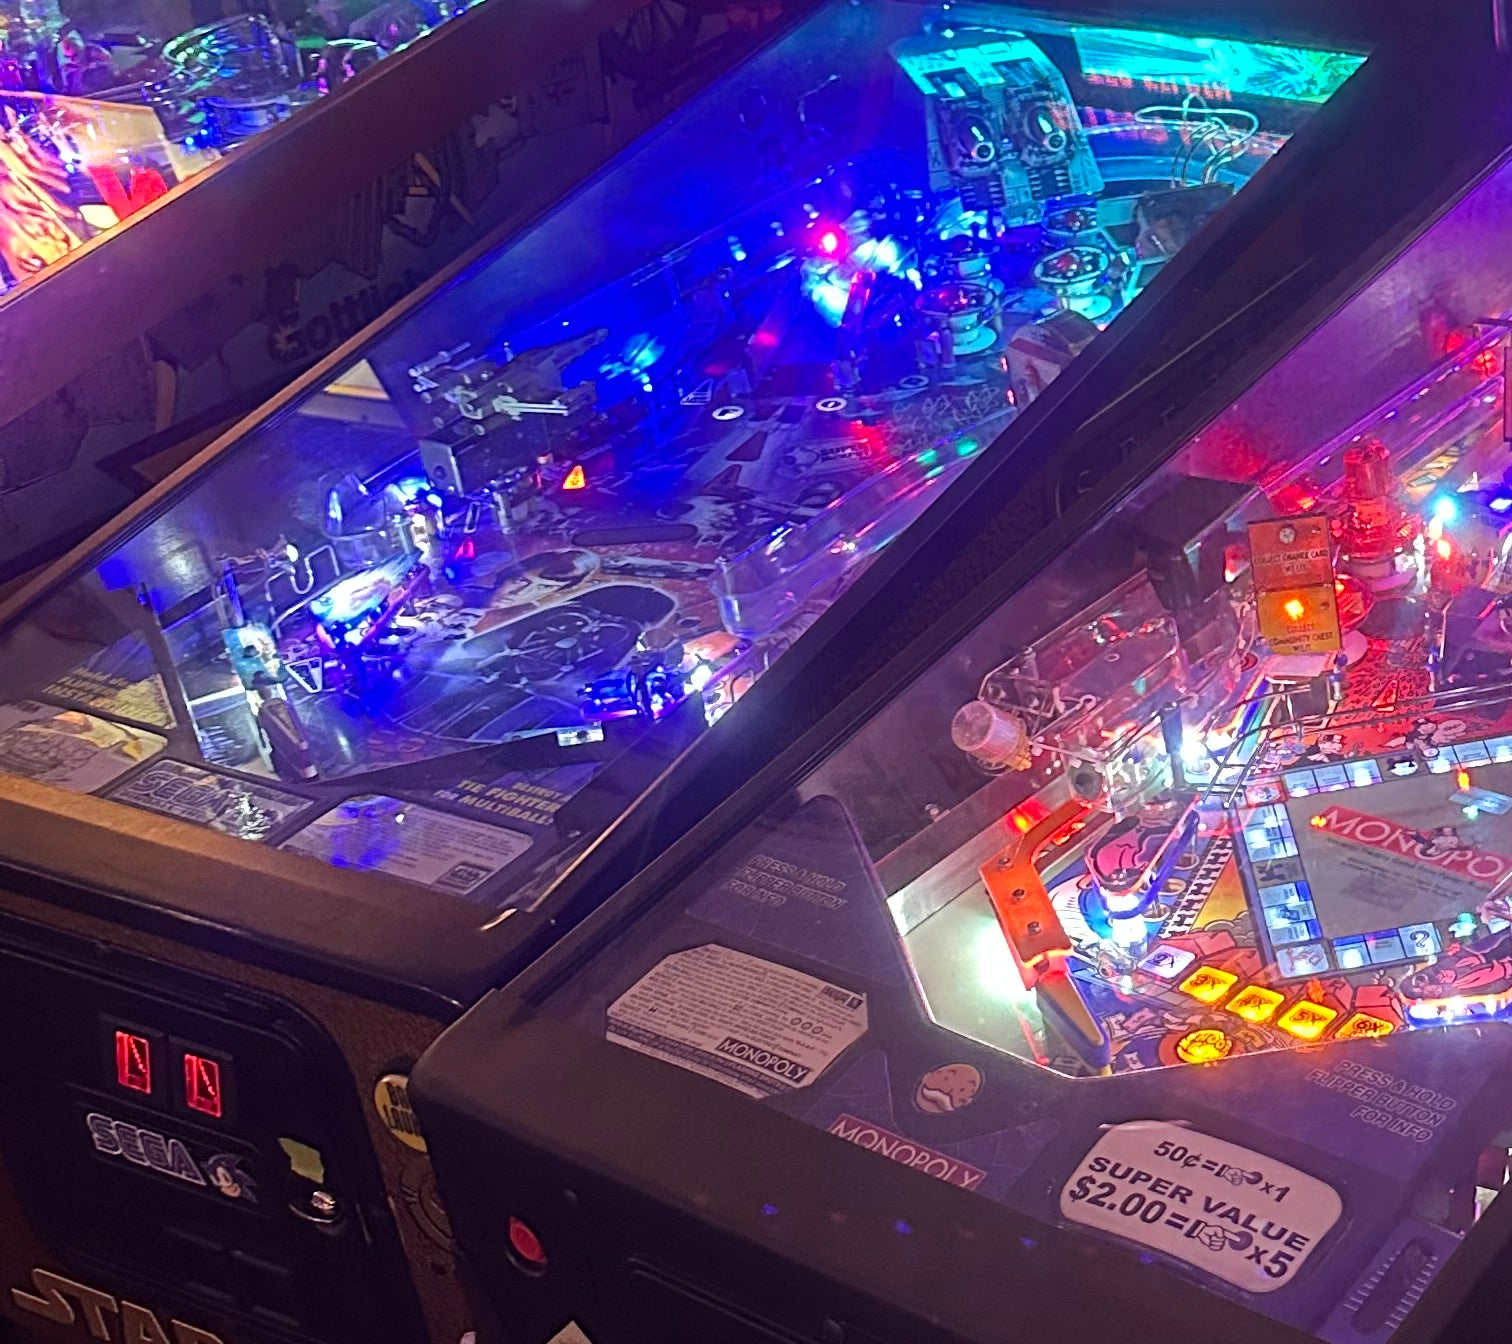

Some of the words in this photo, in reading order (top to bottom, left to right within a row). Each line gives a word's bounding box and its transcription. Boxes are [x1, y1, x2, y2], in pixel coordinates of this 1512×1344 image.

[1311, 631, 1334, 642] CHEST
[433, 789, 457, 801] FOR
[457, 779, 486, 797] TIE
[1324, 808, 1504, 881] MONOPO
[717, 1038, 810, 1083] MONOPOLY
[1334, 1059, 1394, 1089] PRESS
[1405, 1085, 1456, 1111] HOLD
[1305, 1068, 1378, 1104] FLIPPER
[1374, 1093, 1447, 1128] BUTTON
[1350, 1105, 1393, 1129] FOR
[1389, 1118, 1433, 1143] INFO
[85, 1111, 208, 1187] SEGA
[830, 1119, 984, 1190] MONOPOLY
[1087, 1156, 1194, 1205] SUPER
[1202, 1195, 1311, 1253] VALUE
